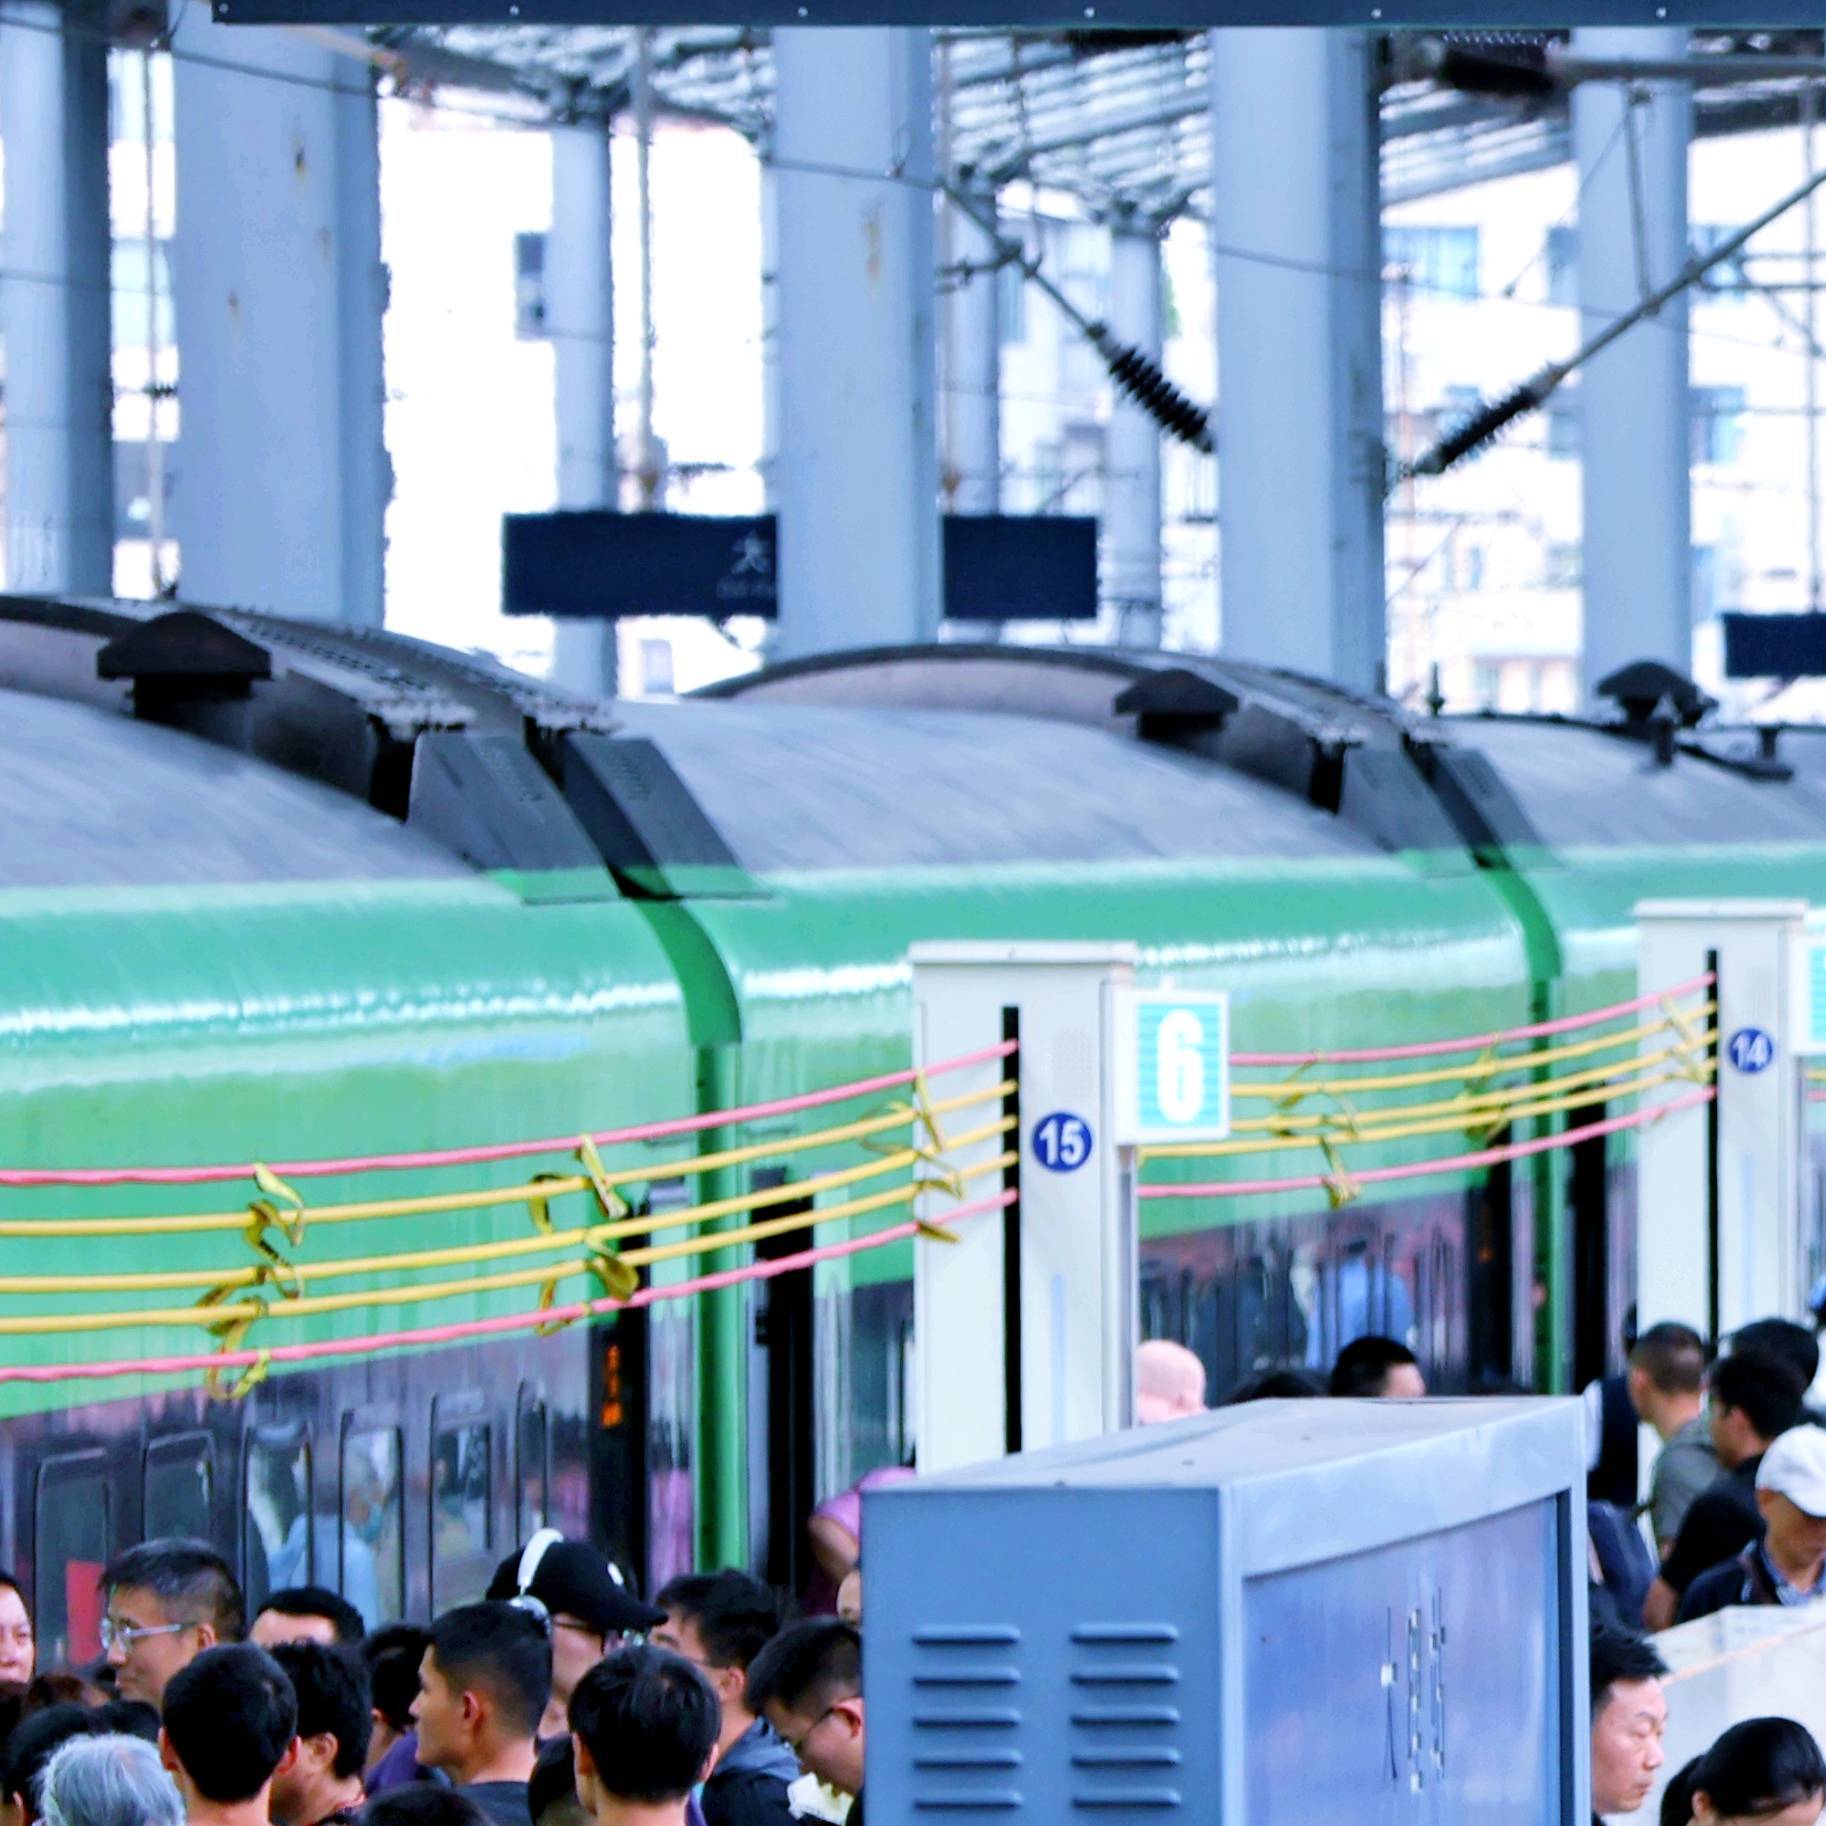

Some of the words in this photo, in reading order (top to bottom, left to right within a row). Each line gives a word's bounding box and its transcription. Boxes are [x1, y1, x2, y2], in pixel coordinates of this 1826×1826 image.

[1156, 1008, 1206, 1123] 6
[1732, 1033, 1771, 1069] 14
[1038, 1122, 1085, 1167] 15
